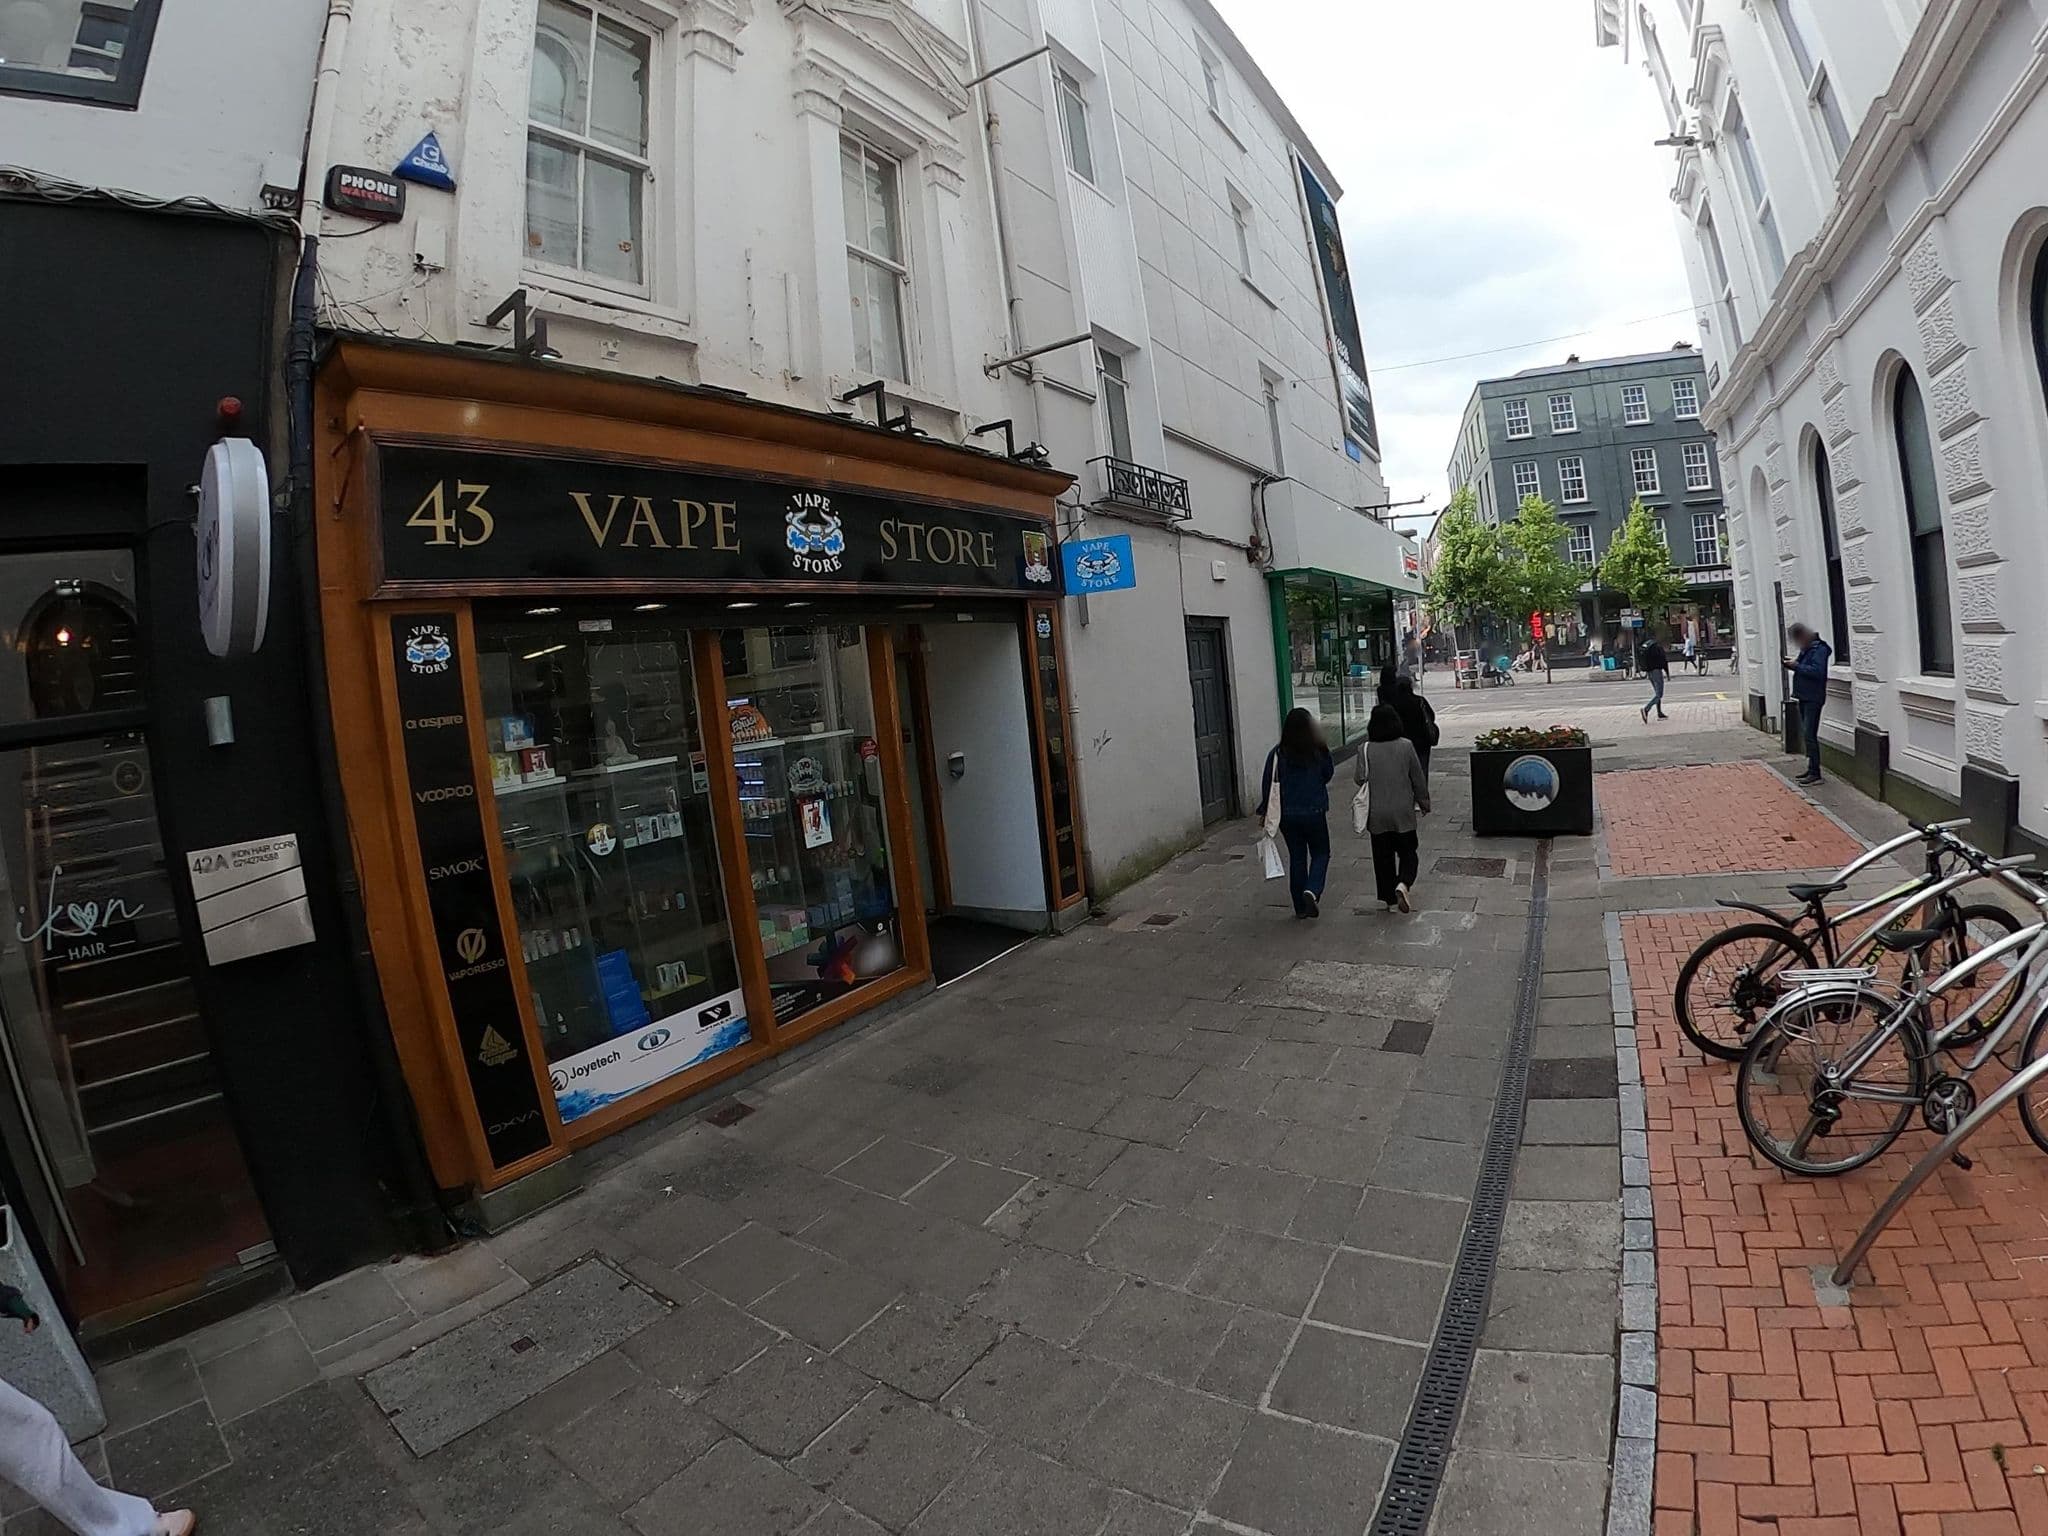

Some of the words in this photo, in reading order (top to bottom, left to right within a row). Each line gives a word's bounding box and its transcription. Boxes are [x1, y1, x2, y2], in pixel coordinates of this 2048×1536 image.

[341, 174, 398, 197] PHONE
[792, 492, 831, 512] VAPE
[405, 479, 495, 549] 43
[567, 491, 742, 555] VAPE
[879, 517, 998, 569] STORE
[1081, 542, 1110, 553] VAPE
[791, 554, 843, 574] STORE
[1080, 574, 1120, 588] STORE
[411, 625, 442, 636] VAPE
[410, 659, 449, 674] STORE
[418, 714, 464, 730] aspire
[415, 785, 474, 803] VOOPOO
[192, 853, 230, 874] 42A
[429, 859, 484, 881] SMOK
[68, 942, 107, 961] HAIR
[448, 957, 506, 982] VAPORESSO
[569, 1050, 622, 1080] Joyetech
